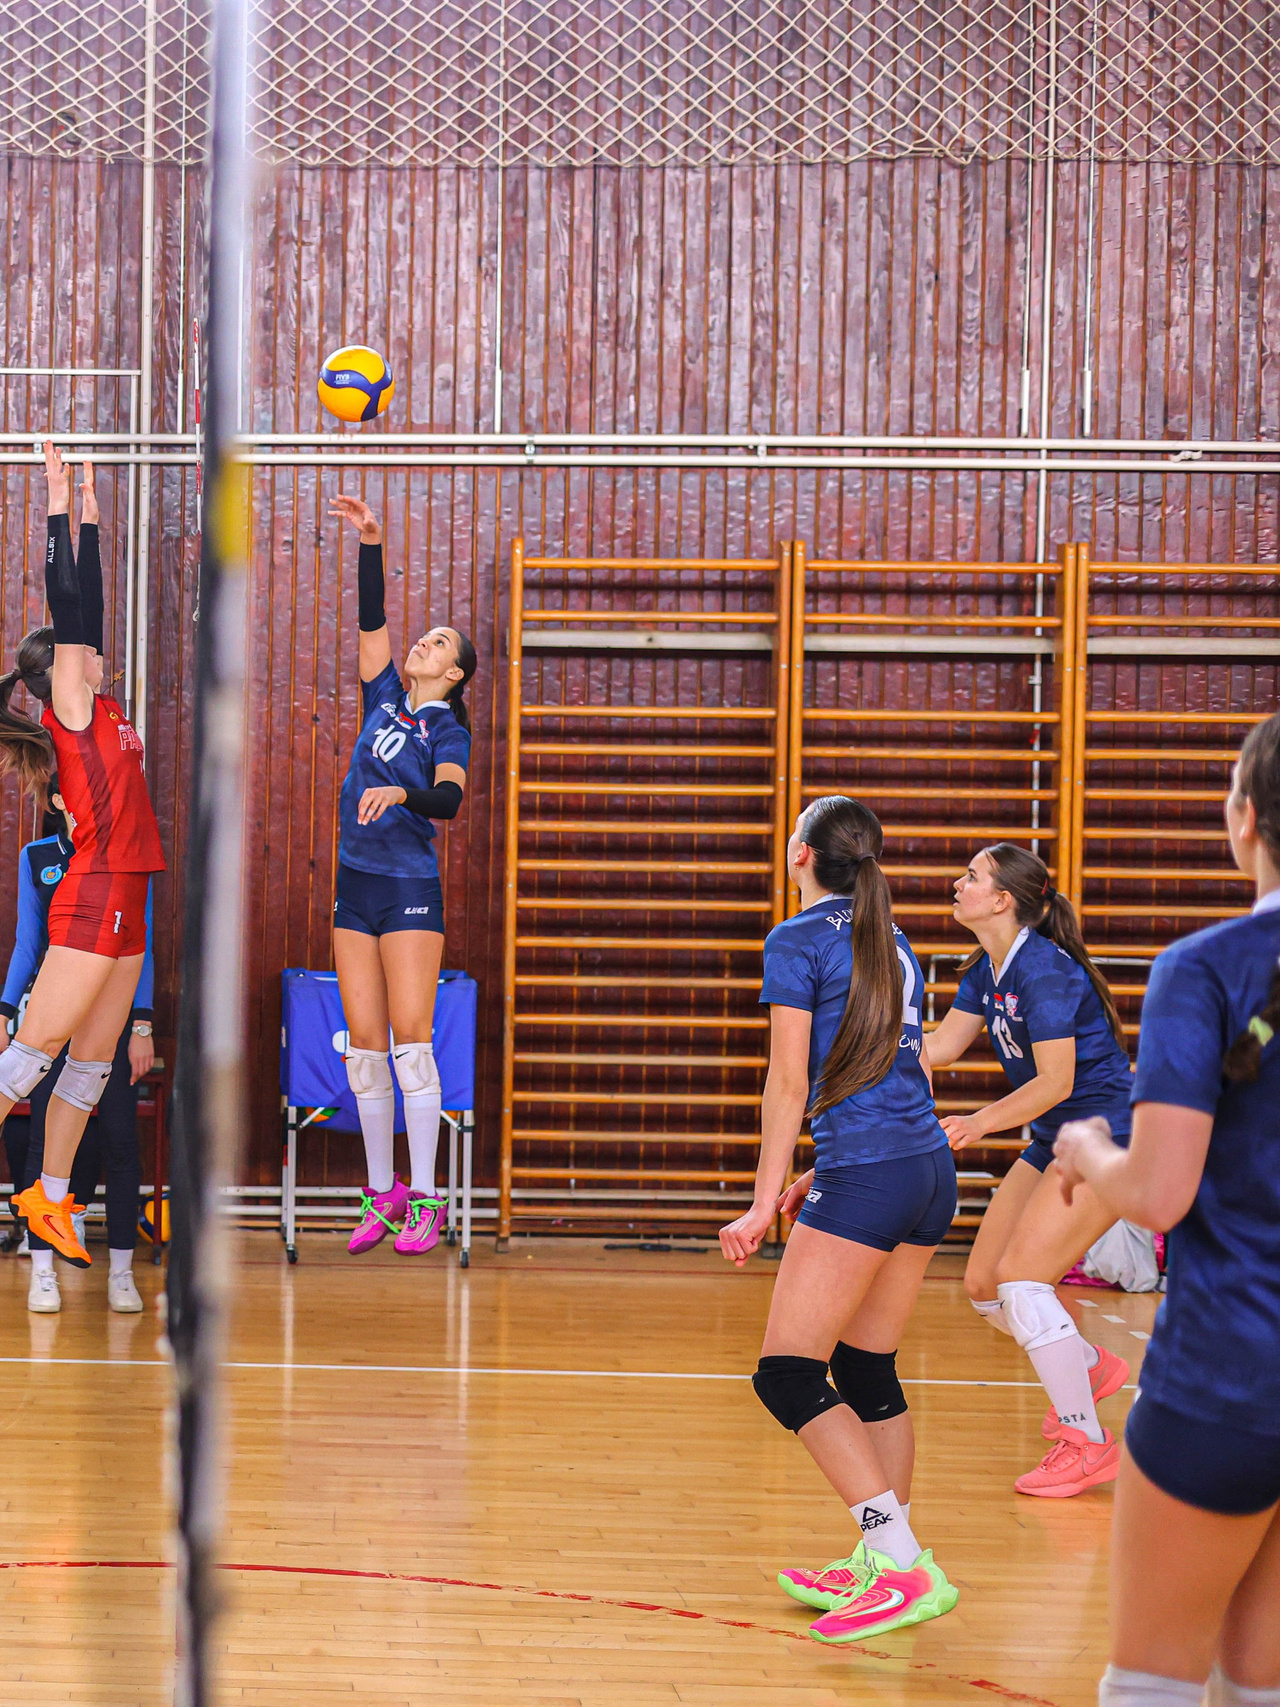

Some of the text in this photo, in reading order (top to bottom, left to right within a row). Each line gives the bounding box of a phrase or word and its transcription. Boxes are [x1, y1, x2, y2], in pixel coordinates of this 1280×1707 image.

[47, 536, 56, 564] ALLSIX
[372, 724, 407, 763] 10
[113, 910, 122, 934] 1
[992, 1015, 1024, 1059] 13
[859, 1512, 894, 1533] PEAK
